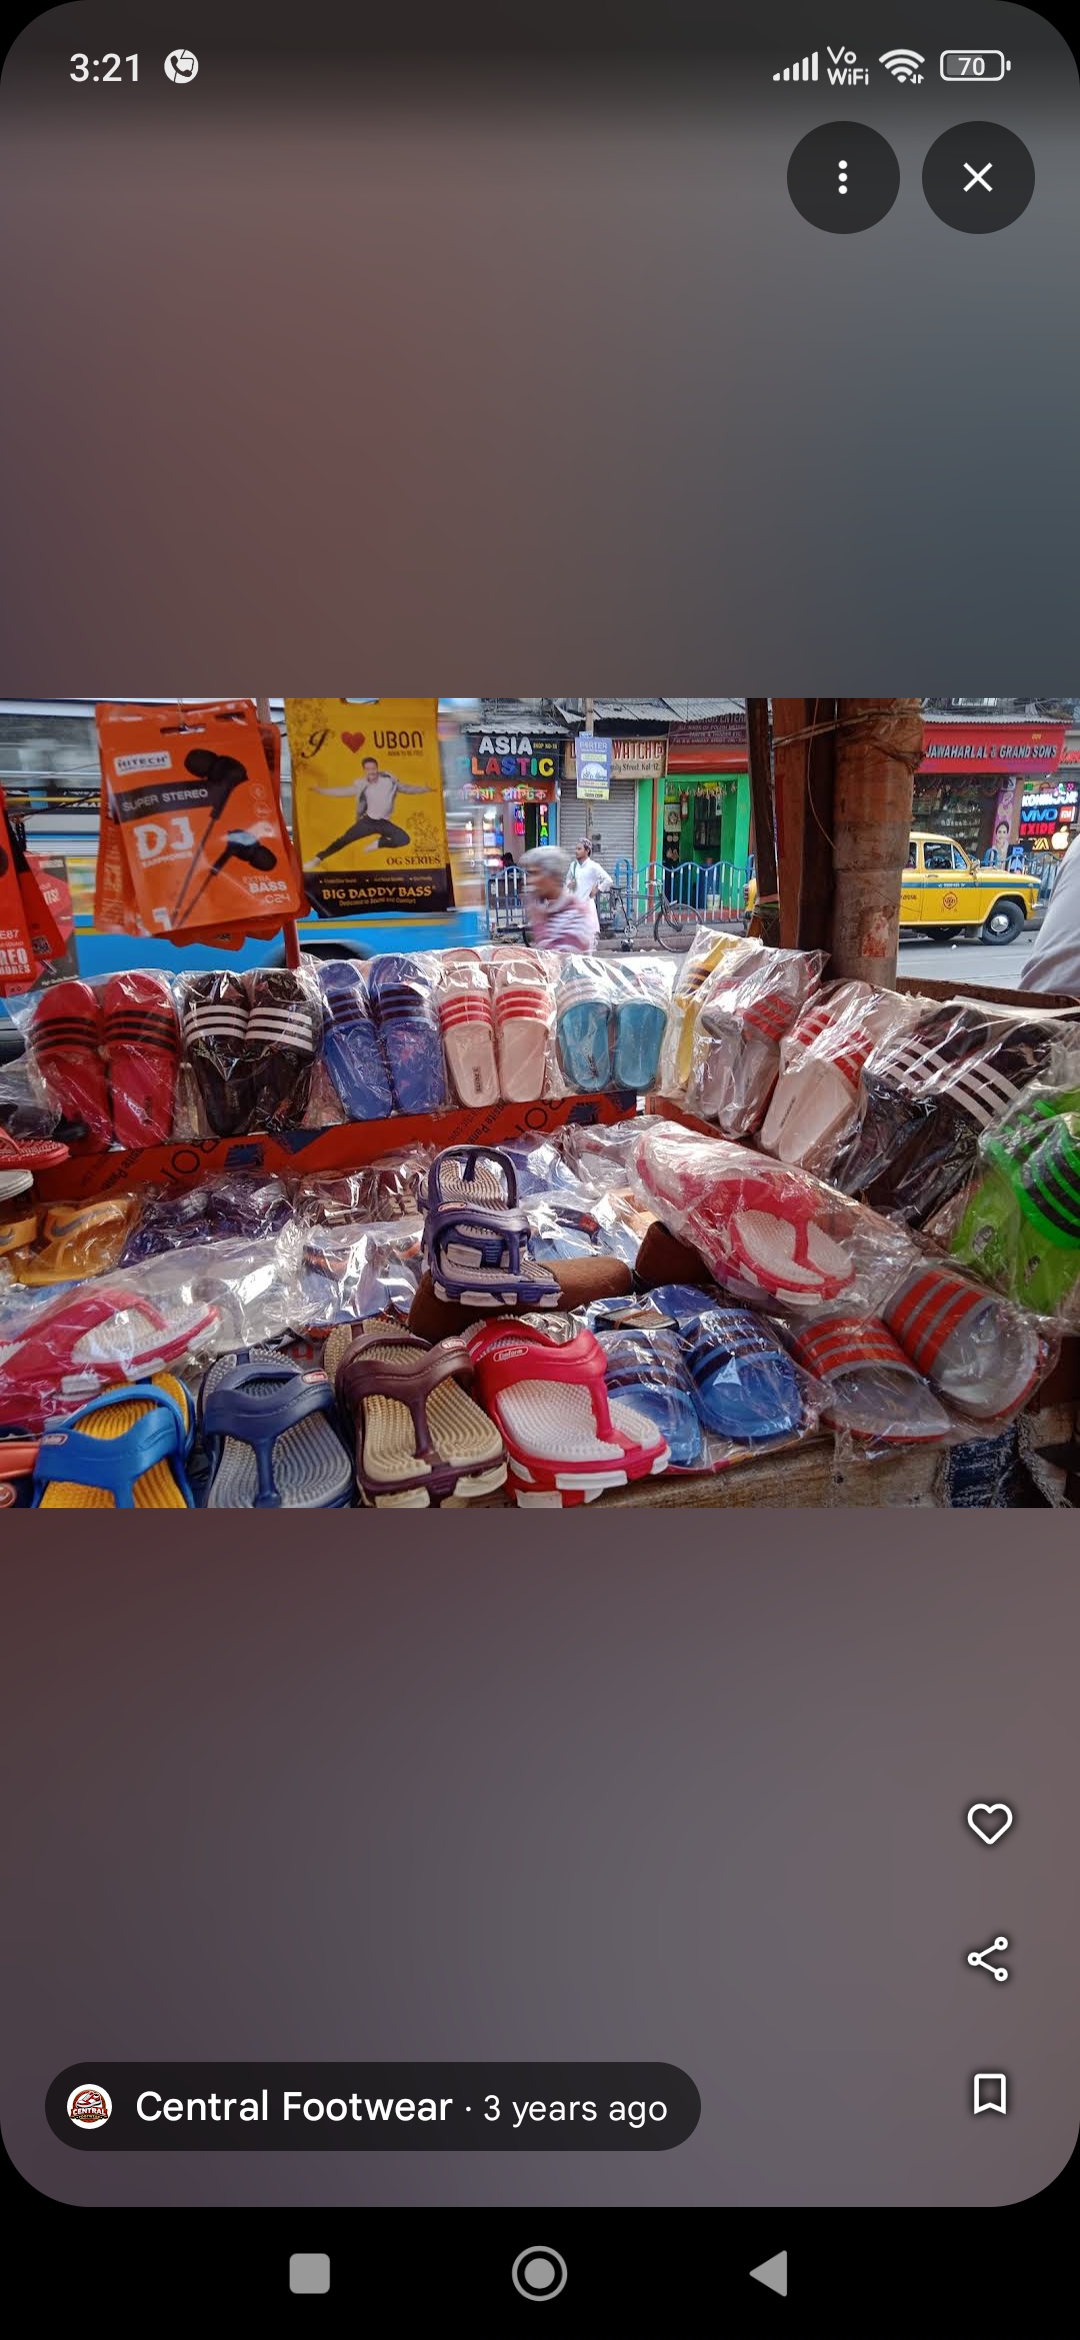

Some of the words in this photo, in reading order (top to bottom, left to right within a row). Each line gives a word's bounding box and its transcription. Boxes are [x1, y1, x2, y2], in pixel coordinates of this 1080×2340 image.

[373, 730, 423, 749] UBON
[479, 736, 533, 755] ASIA
[613, 740, 653, 760] WATCH
[926, 744, 988, 758] JAWAHARLAL
[1000, 745, 1030, 759] GRAND
[1032, 745, 1057, 758] SONS
[118, 756, 166, 769] HITECH
[457, 757, 554, 777] PLASTIC
[122, 795, 160, 812] SUPER
[162, 788, 209, 803] STEREO
[133, 816, 195, 860] DJ
[386, 857, 402, 866] OG
[404, 855, 440, 865] SERIES
[249, 881, 288, 893] BASS
[322, 889, 346, 900] BIG
[348, 887, 397, 899] DADDY
[399, 885, 433, 897] BASS
